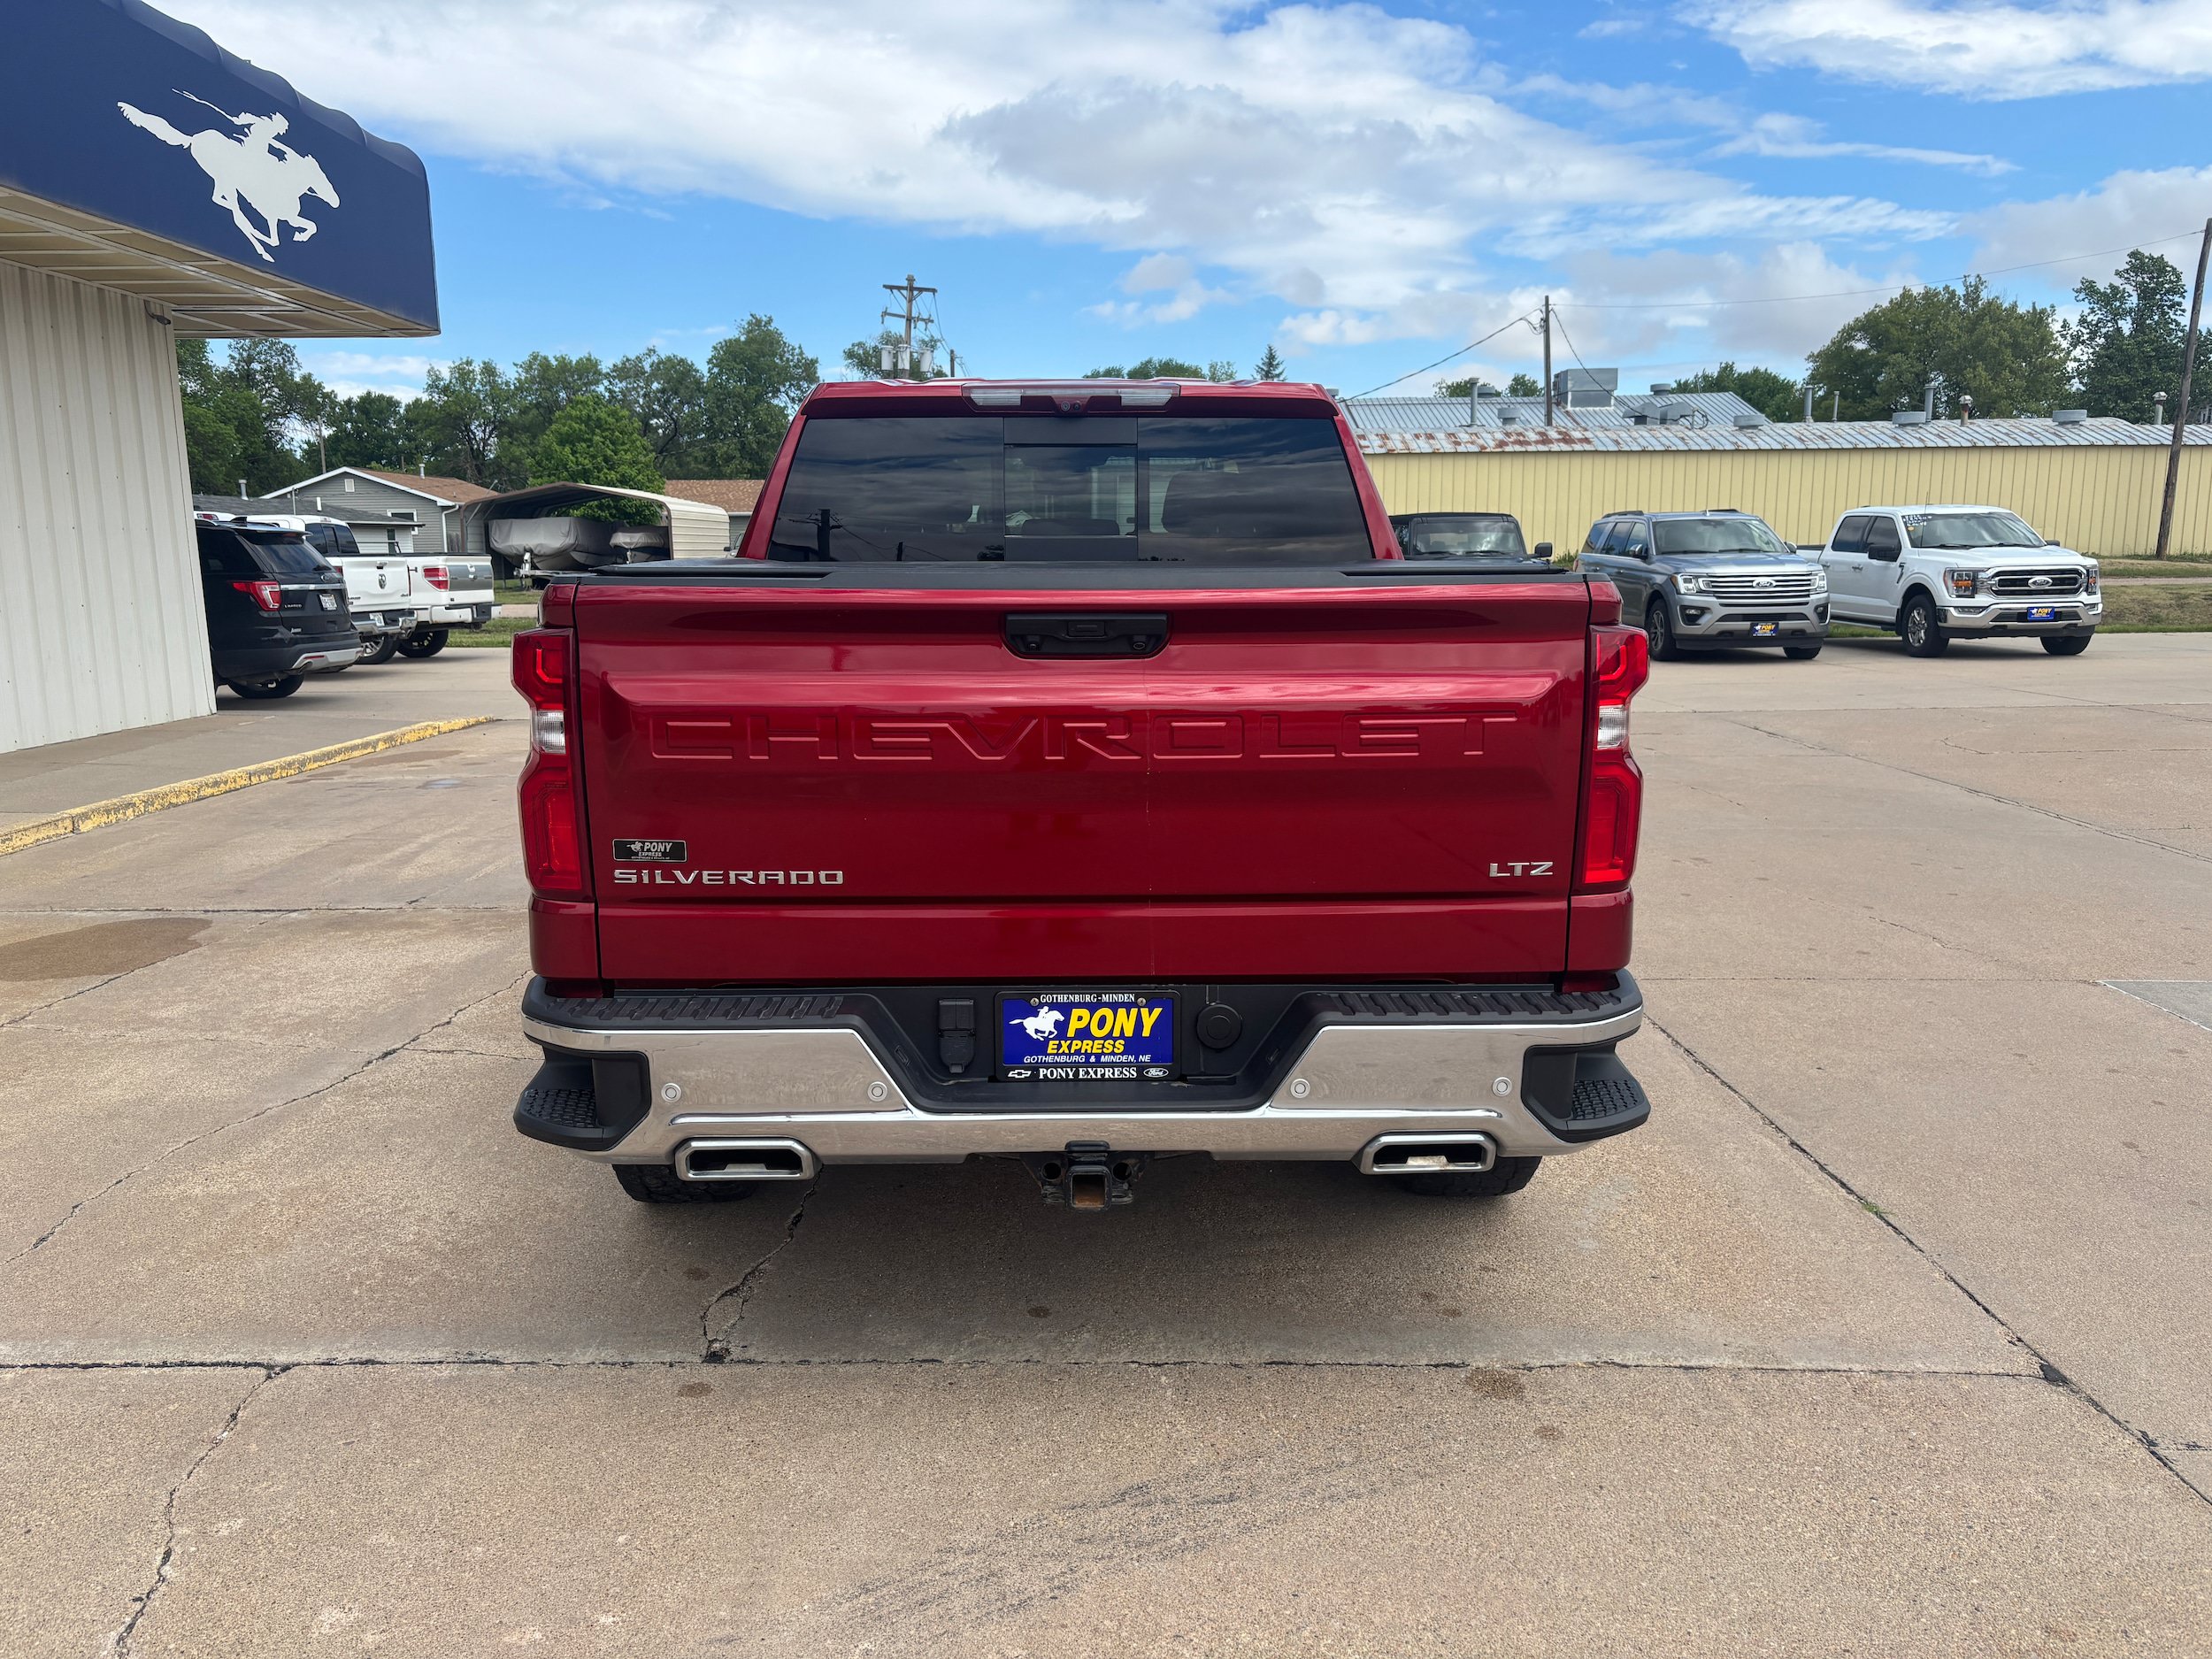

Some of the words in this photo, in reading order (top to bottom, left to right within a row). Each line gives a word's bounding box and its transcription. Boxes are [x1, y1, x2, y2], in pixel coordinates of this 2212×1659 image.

[650, 710, 1518, 760] CHEVROLET
[643, 842, 673, 852] PONY
[1489, 861, 1554, 878] LTZ
[613, 869, 844, 885] SILVERADO
[1040, 994, 1135, 1003] GOTHENBURG-MINDEN
[1066, 1007, 1164, 1038] PONY
[1047, 1040, 1125, 1054] EXPRESS
[1023, 1055, 1086, 1064] GOTHENBURG
[1100, 1055, 1137, 1064] MINDEN,
[1039, 1068, 1076, 1079] PONY
[1078, 1067, 1137, 1079] EXPRESS
[1147, 1068, 1166, 1077] Ford
